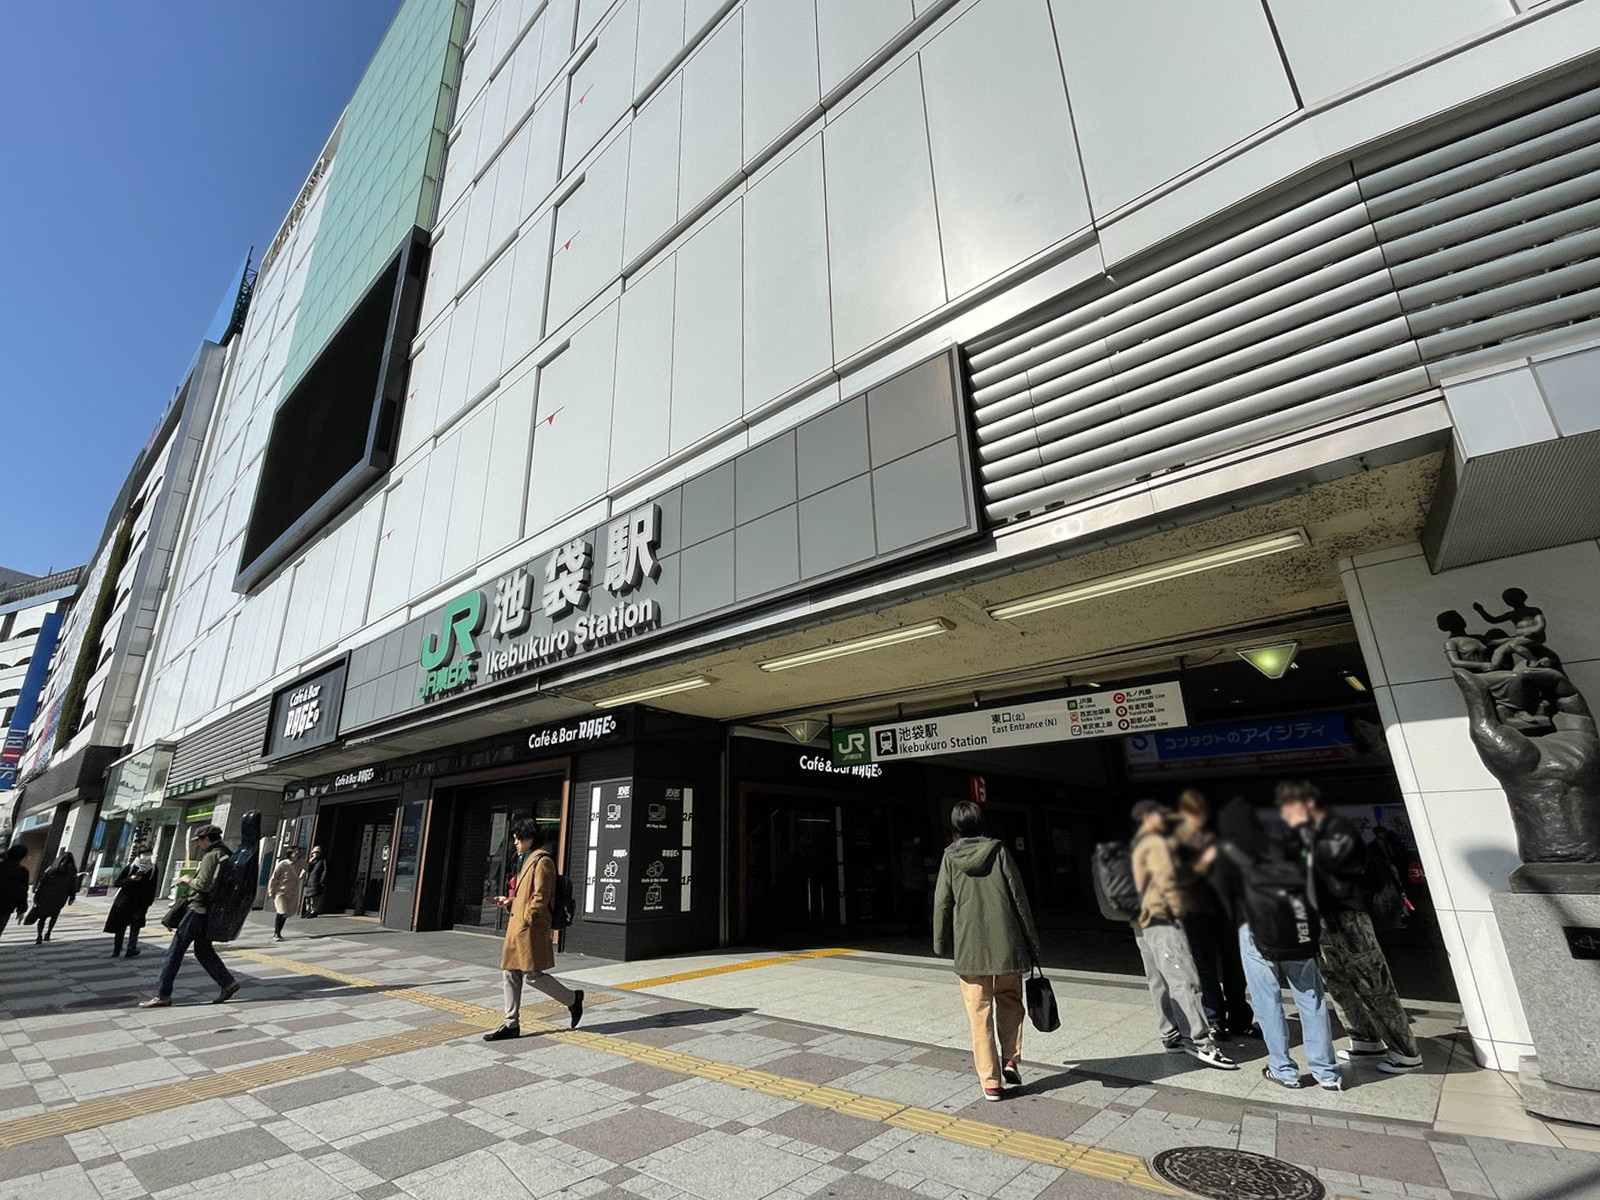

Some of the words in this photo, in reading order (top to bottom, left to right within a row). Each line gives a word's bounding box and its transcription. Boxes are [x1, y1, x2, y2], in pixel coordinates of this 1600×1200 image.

[491, 503, 661, 638] 池袋駅
[420, 590, 482, 670] JR
[486, 630, 569, 675] Ikebukuro
[574, 599, 654, 646] Station
[991, 713, 1025, 724] 東口(北)
[992, 726, 1009, 734] East
[1010, 722, 1044, 731] Entrance
[1045, 718, 1057, 727] (N)
[528, 730, 550, 749] Café
[551, 731, 558, 745] &
[559, 727, 578, 743] Bar
[579, 715, 613, 740] RAGE
[899, 723, 938, 741] 池袋駅
[1165, 722, 1326, 750] コンタクトのアイシティ
[838, 733, 865, 754] JR
[900, 741, 947, 754] Ikebukuro
[950, 735, 987, 748] Station
[800, 755, 824, 771] Café
[825, 760, 832, 773] &
[591, 813, 600, 822] 2F
[682, 812, 693, 822] 2F
[1296, 922, 1312, 944] ERA
